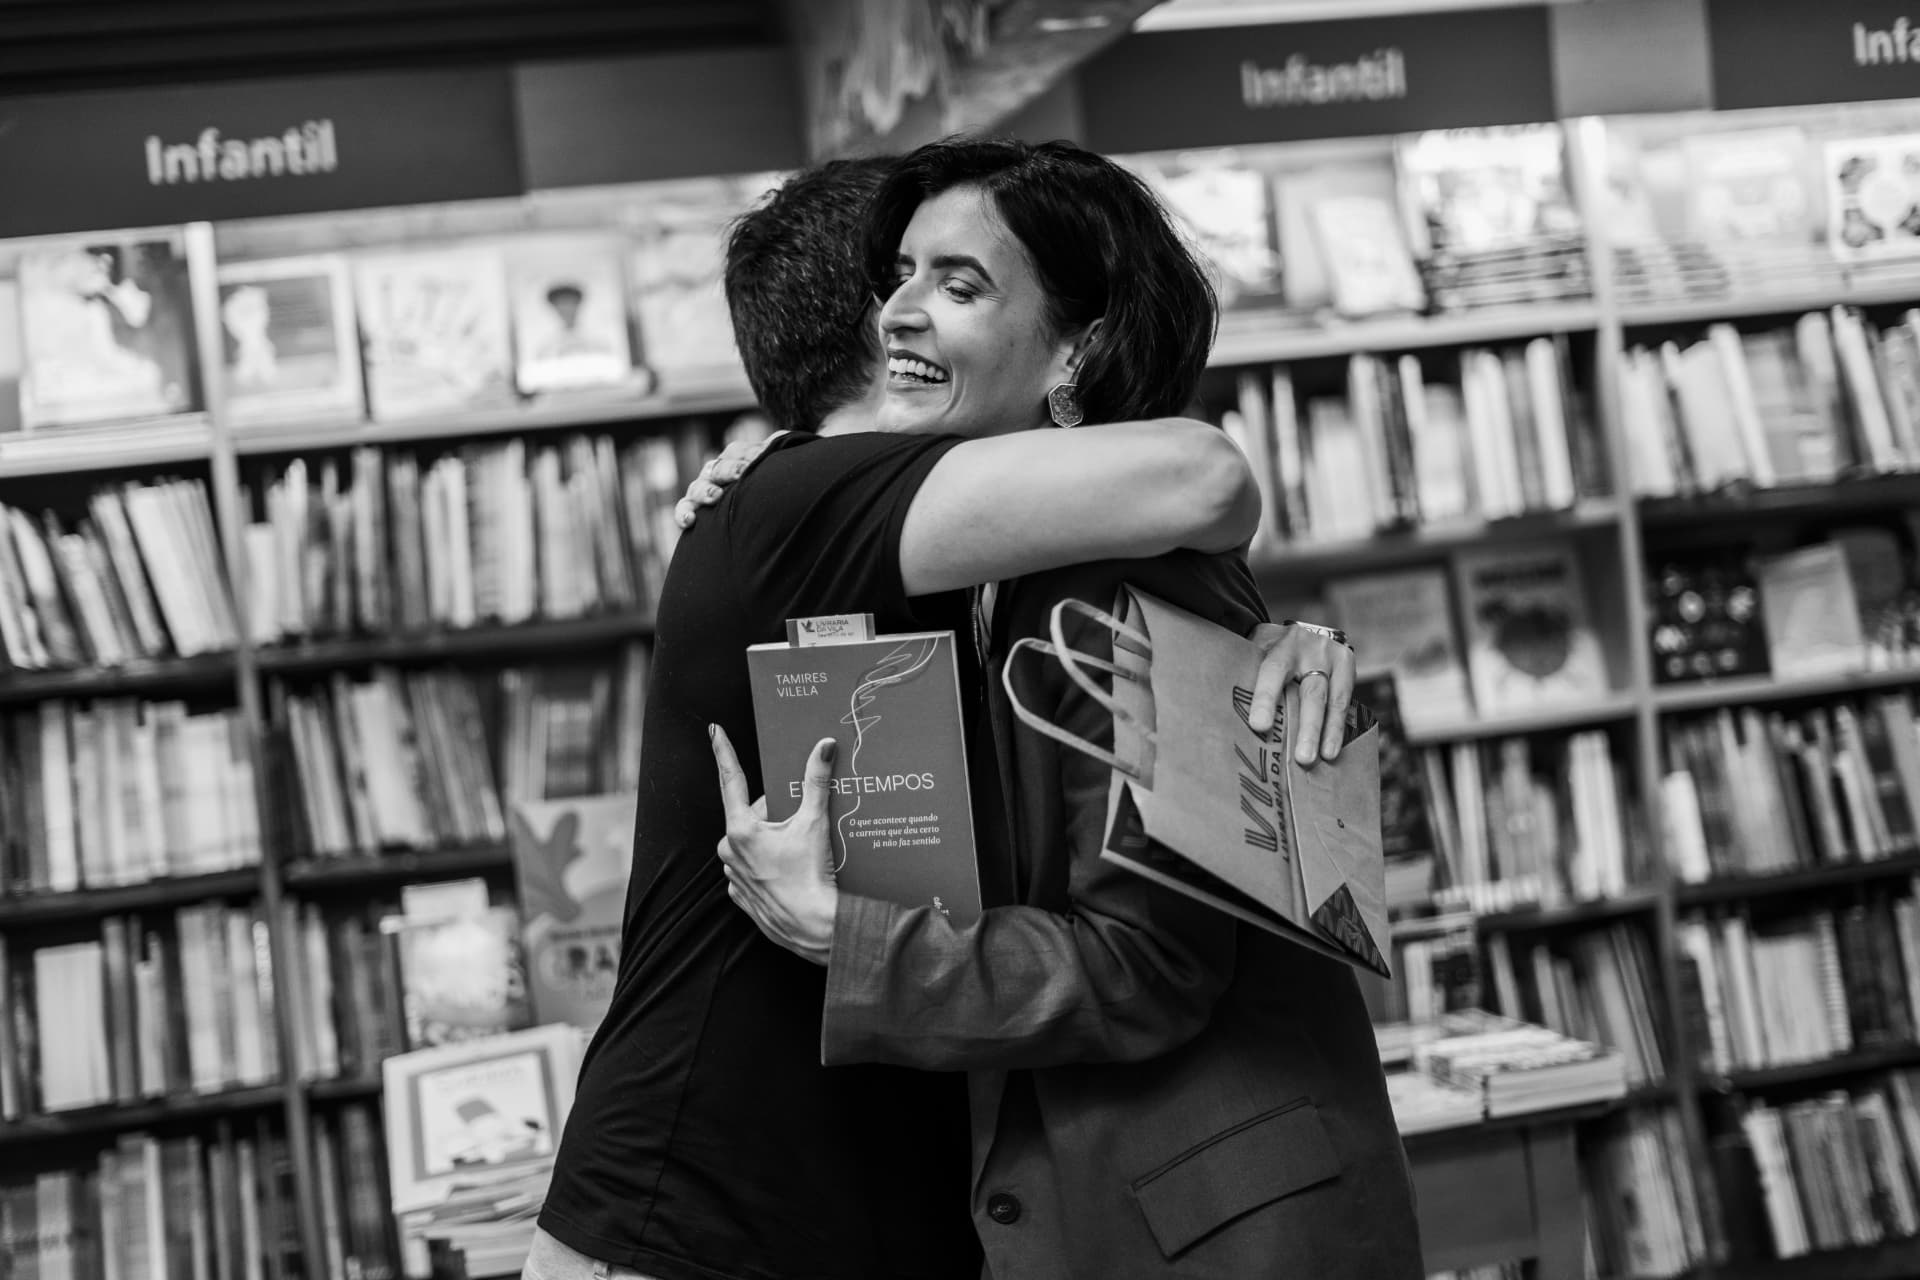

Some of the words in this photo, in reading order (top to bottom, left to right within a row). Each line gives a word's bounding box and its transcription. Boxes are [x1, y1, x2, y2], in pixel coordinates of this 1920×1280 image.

[1240, 46, 1407, 109] Infantil
[145, 118, 337, 185] Infantil
[775, 672, 828, 685] TAMIRES
[776, 685, 819, 697] VILELA
[1272, 704, 1284, 744] VILA
[1271, 751, 1281, 775] DA
[789, 772, 935, 798] ERETEMPOS
[849, 818, 856, 826] O
[857, 818, 872, 828] que
[873, 816, 907, 825] acontece
[908, 812, 939, 825] quando
[856, 829, 887, 838] carreira
[887, 828, 902, 837] que
[903, 826, 918, 835] deu
[919, 826, 940, 834] certo
[1272, 780, 1290, 864] LIVRARIA
[873, 839, 881, 849] já
[882, 839, 898, 847] não
[898, 837, 911, 849] faz
[912, 836, 941, 845] sentido
